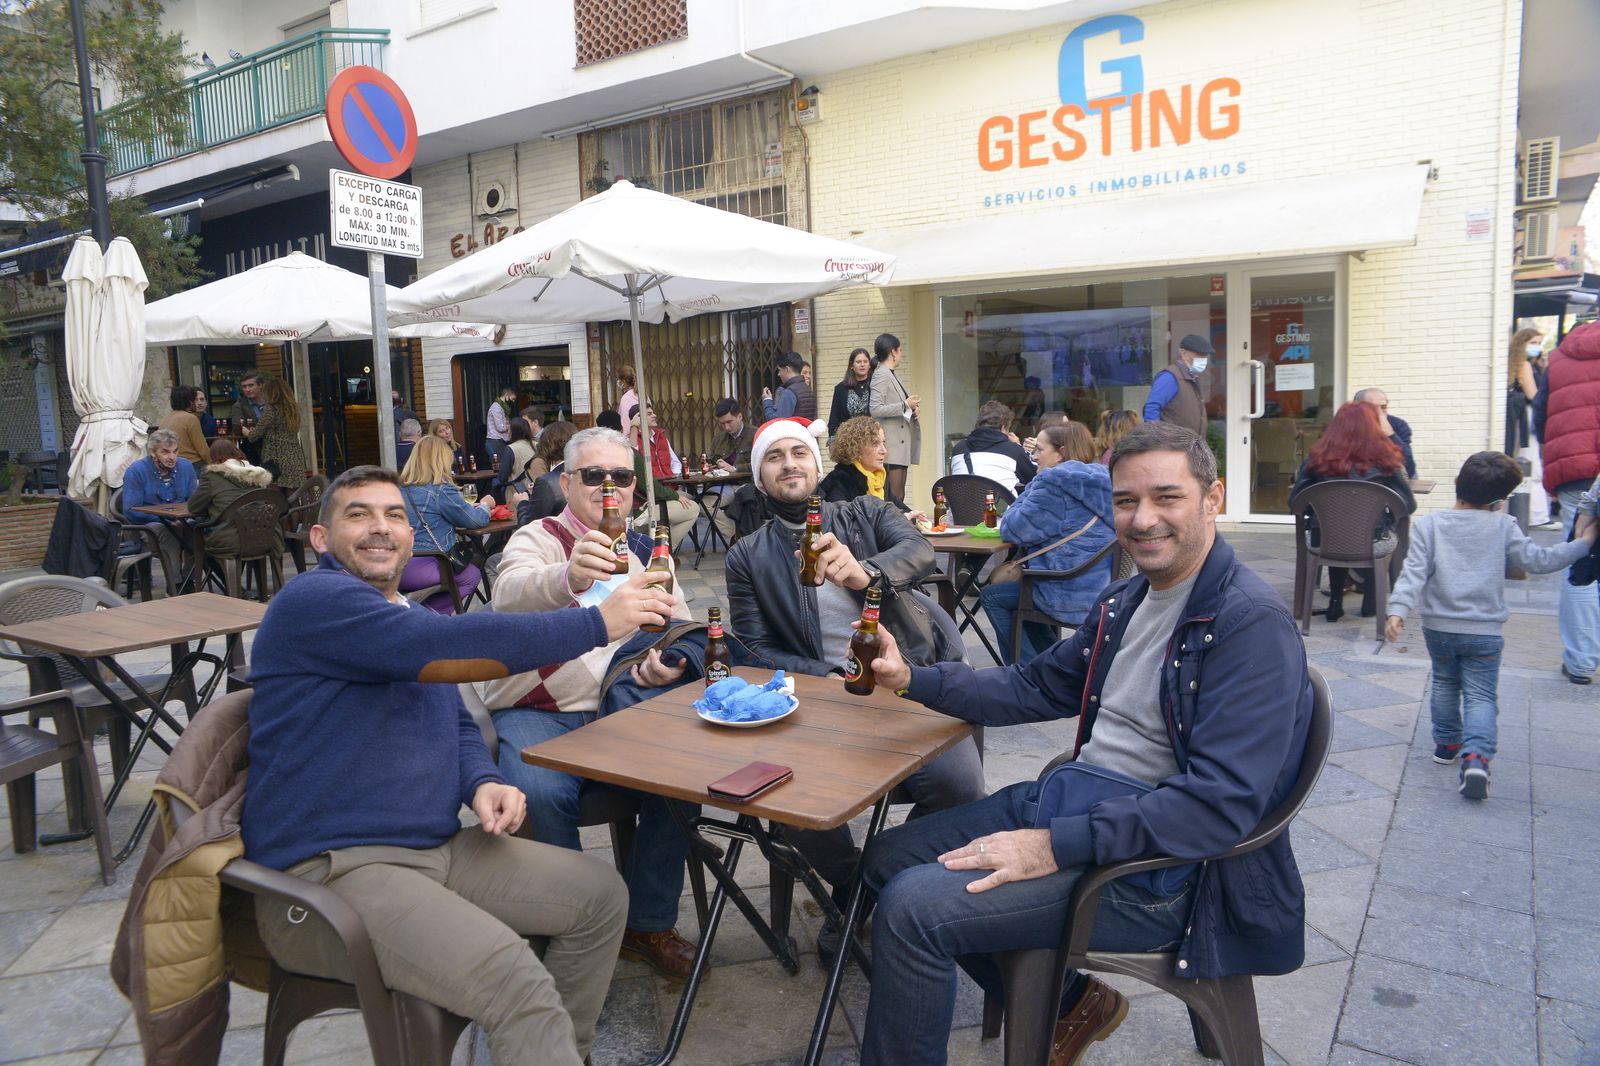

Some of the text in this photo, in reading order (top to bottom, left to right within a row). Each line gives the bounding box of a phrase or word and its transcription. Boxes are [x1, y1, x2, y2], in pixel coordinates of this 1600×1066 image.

[1058, 14, 1144, 115] G
[977, 77, 1241, 172] GESTING
[338, 176, 417, 200] EXCEPTO CARGA
[984, 161, 1247, 208] SERVICIOS INMOBILIARIOS
[349, 192, 408, 212] Y DESCARGA
[340, 204, 350, 214] de
[354, 206, 372, 218] 8.00
[386, 212, 407, 224] 12:00
[376, 224, 386, 234] 30
[390, 226, 410, 238] MIN.
[339, 231, 378, 245] LONGITUD
[400, 241, 405, 250] 5
[407, 243, 420, 252] mts
[242, 324, 300, 338] Cruzcampo
[1276, 334, 1310, 343] GESTING
[1280, 345, 1311, 360] API
